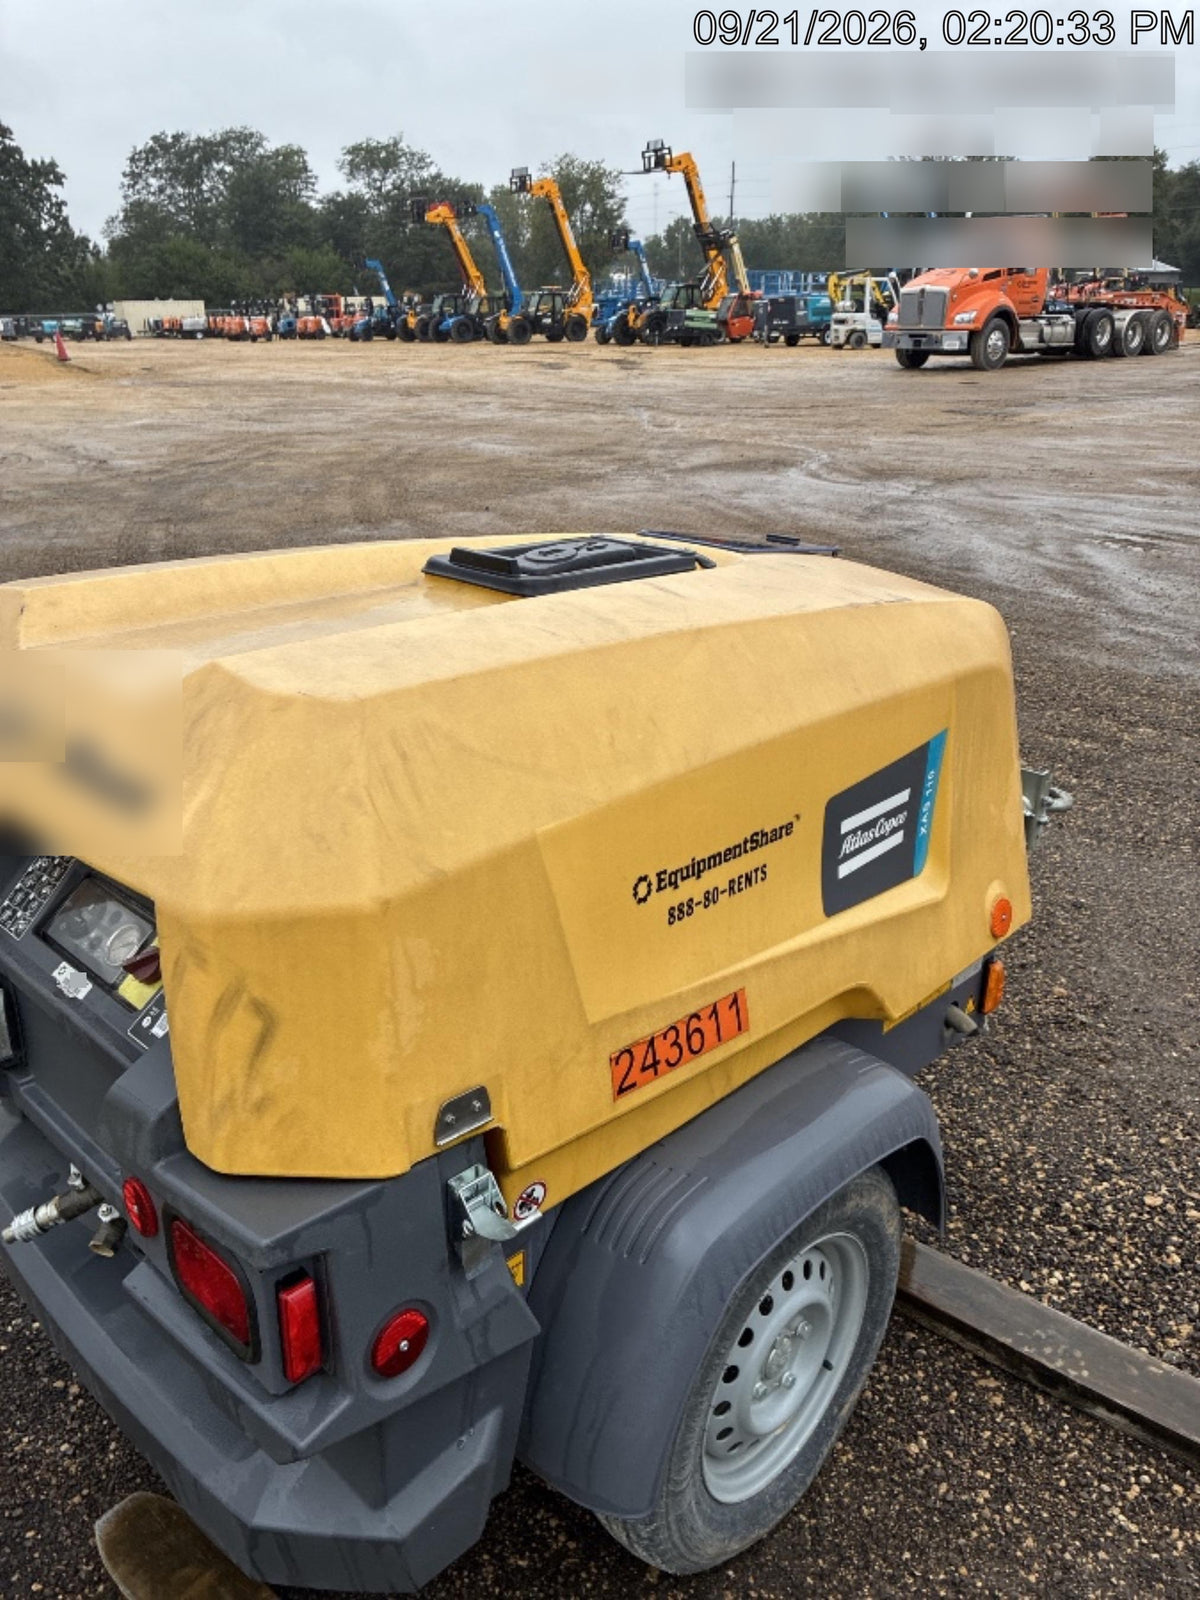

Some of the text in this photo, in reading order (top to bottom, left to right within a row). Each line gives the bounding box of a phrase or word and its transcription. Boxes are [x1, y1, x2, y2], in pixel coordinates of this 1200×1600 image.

[655, 821, 794, 893] EquipmentShare
[667, 863, 768, 926] 888-80-RENTS
[615, 991, 743, 1096] 243611
